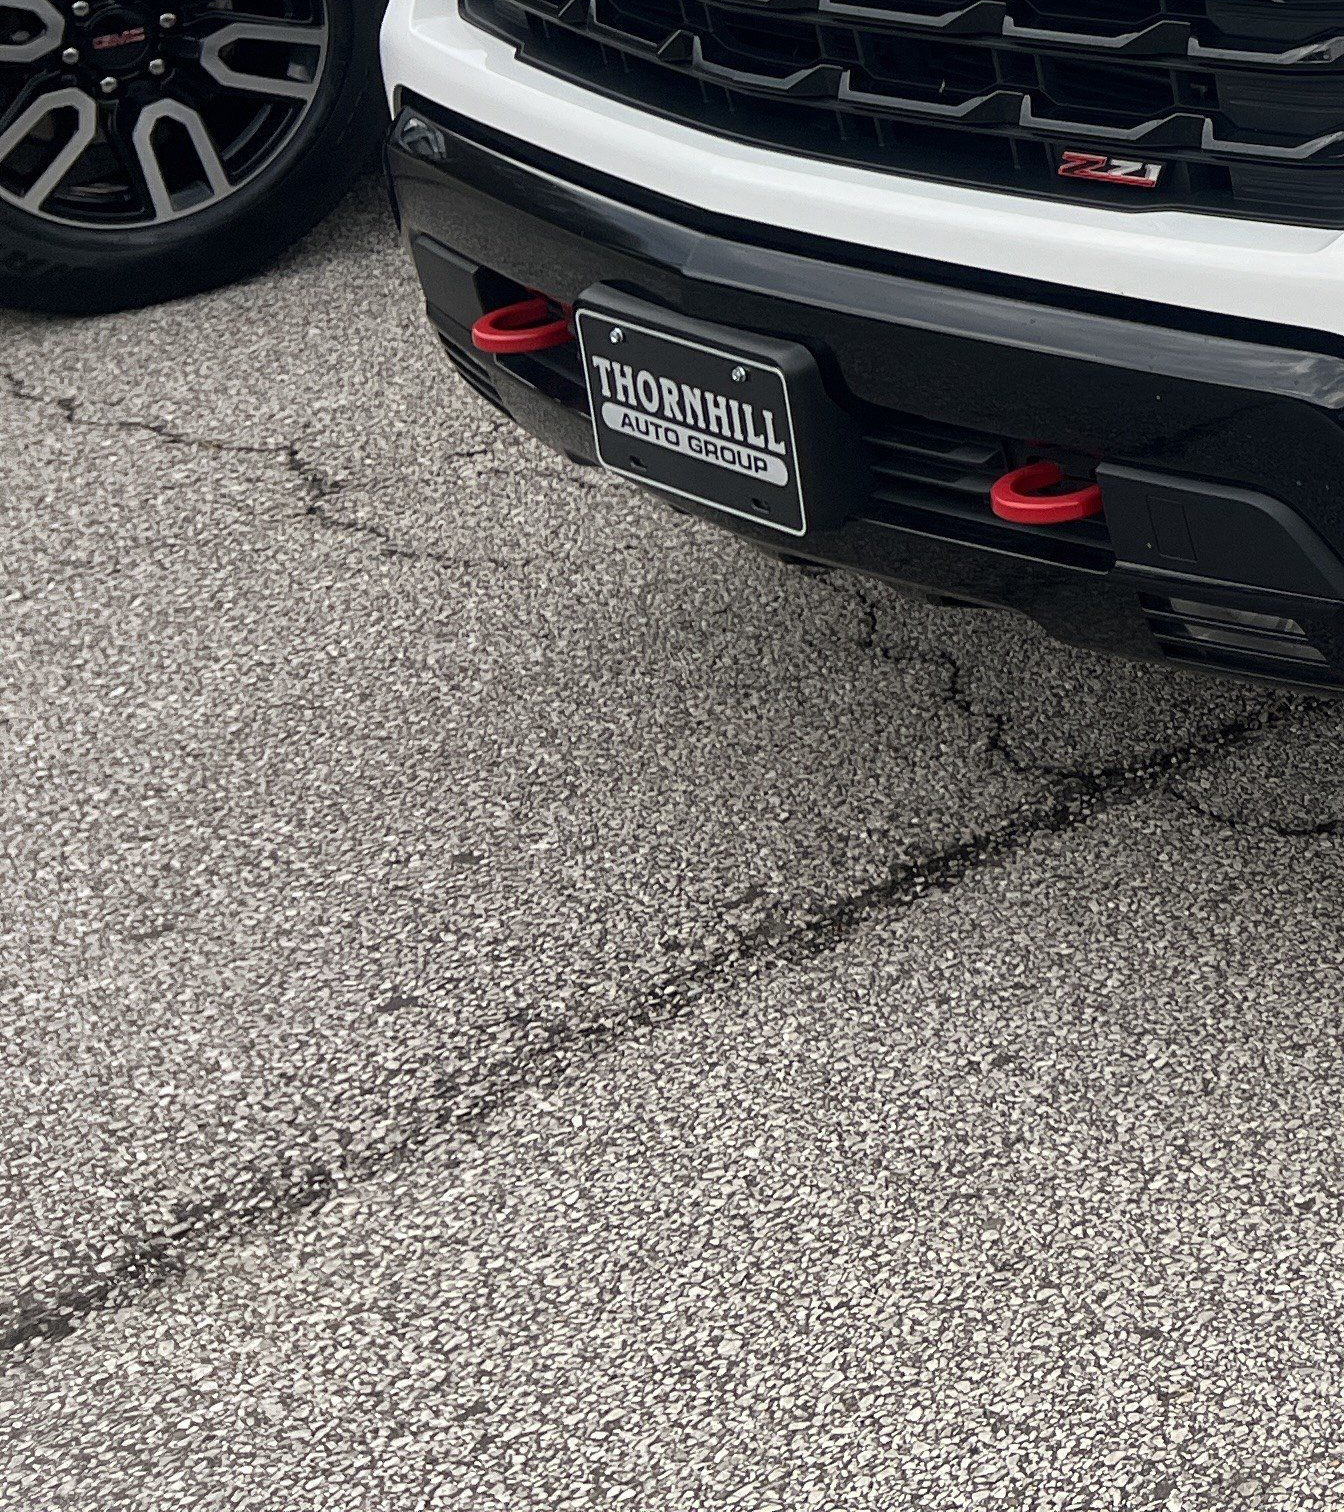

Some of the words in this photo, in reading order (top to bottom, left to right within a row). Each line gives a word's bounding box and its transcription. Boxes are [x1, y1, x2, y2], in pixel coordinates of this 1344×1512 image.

[92, 27, 146, 49] GMC
[1058, 150, 1162, 188] Z71
[592, 355, 786, 455] THORNHILL
[621, 412, 680, 446] AUTO
[688, 434, 767, 473] GROUP
